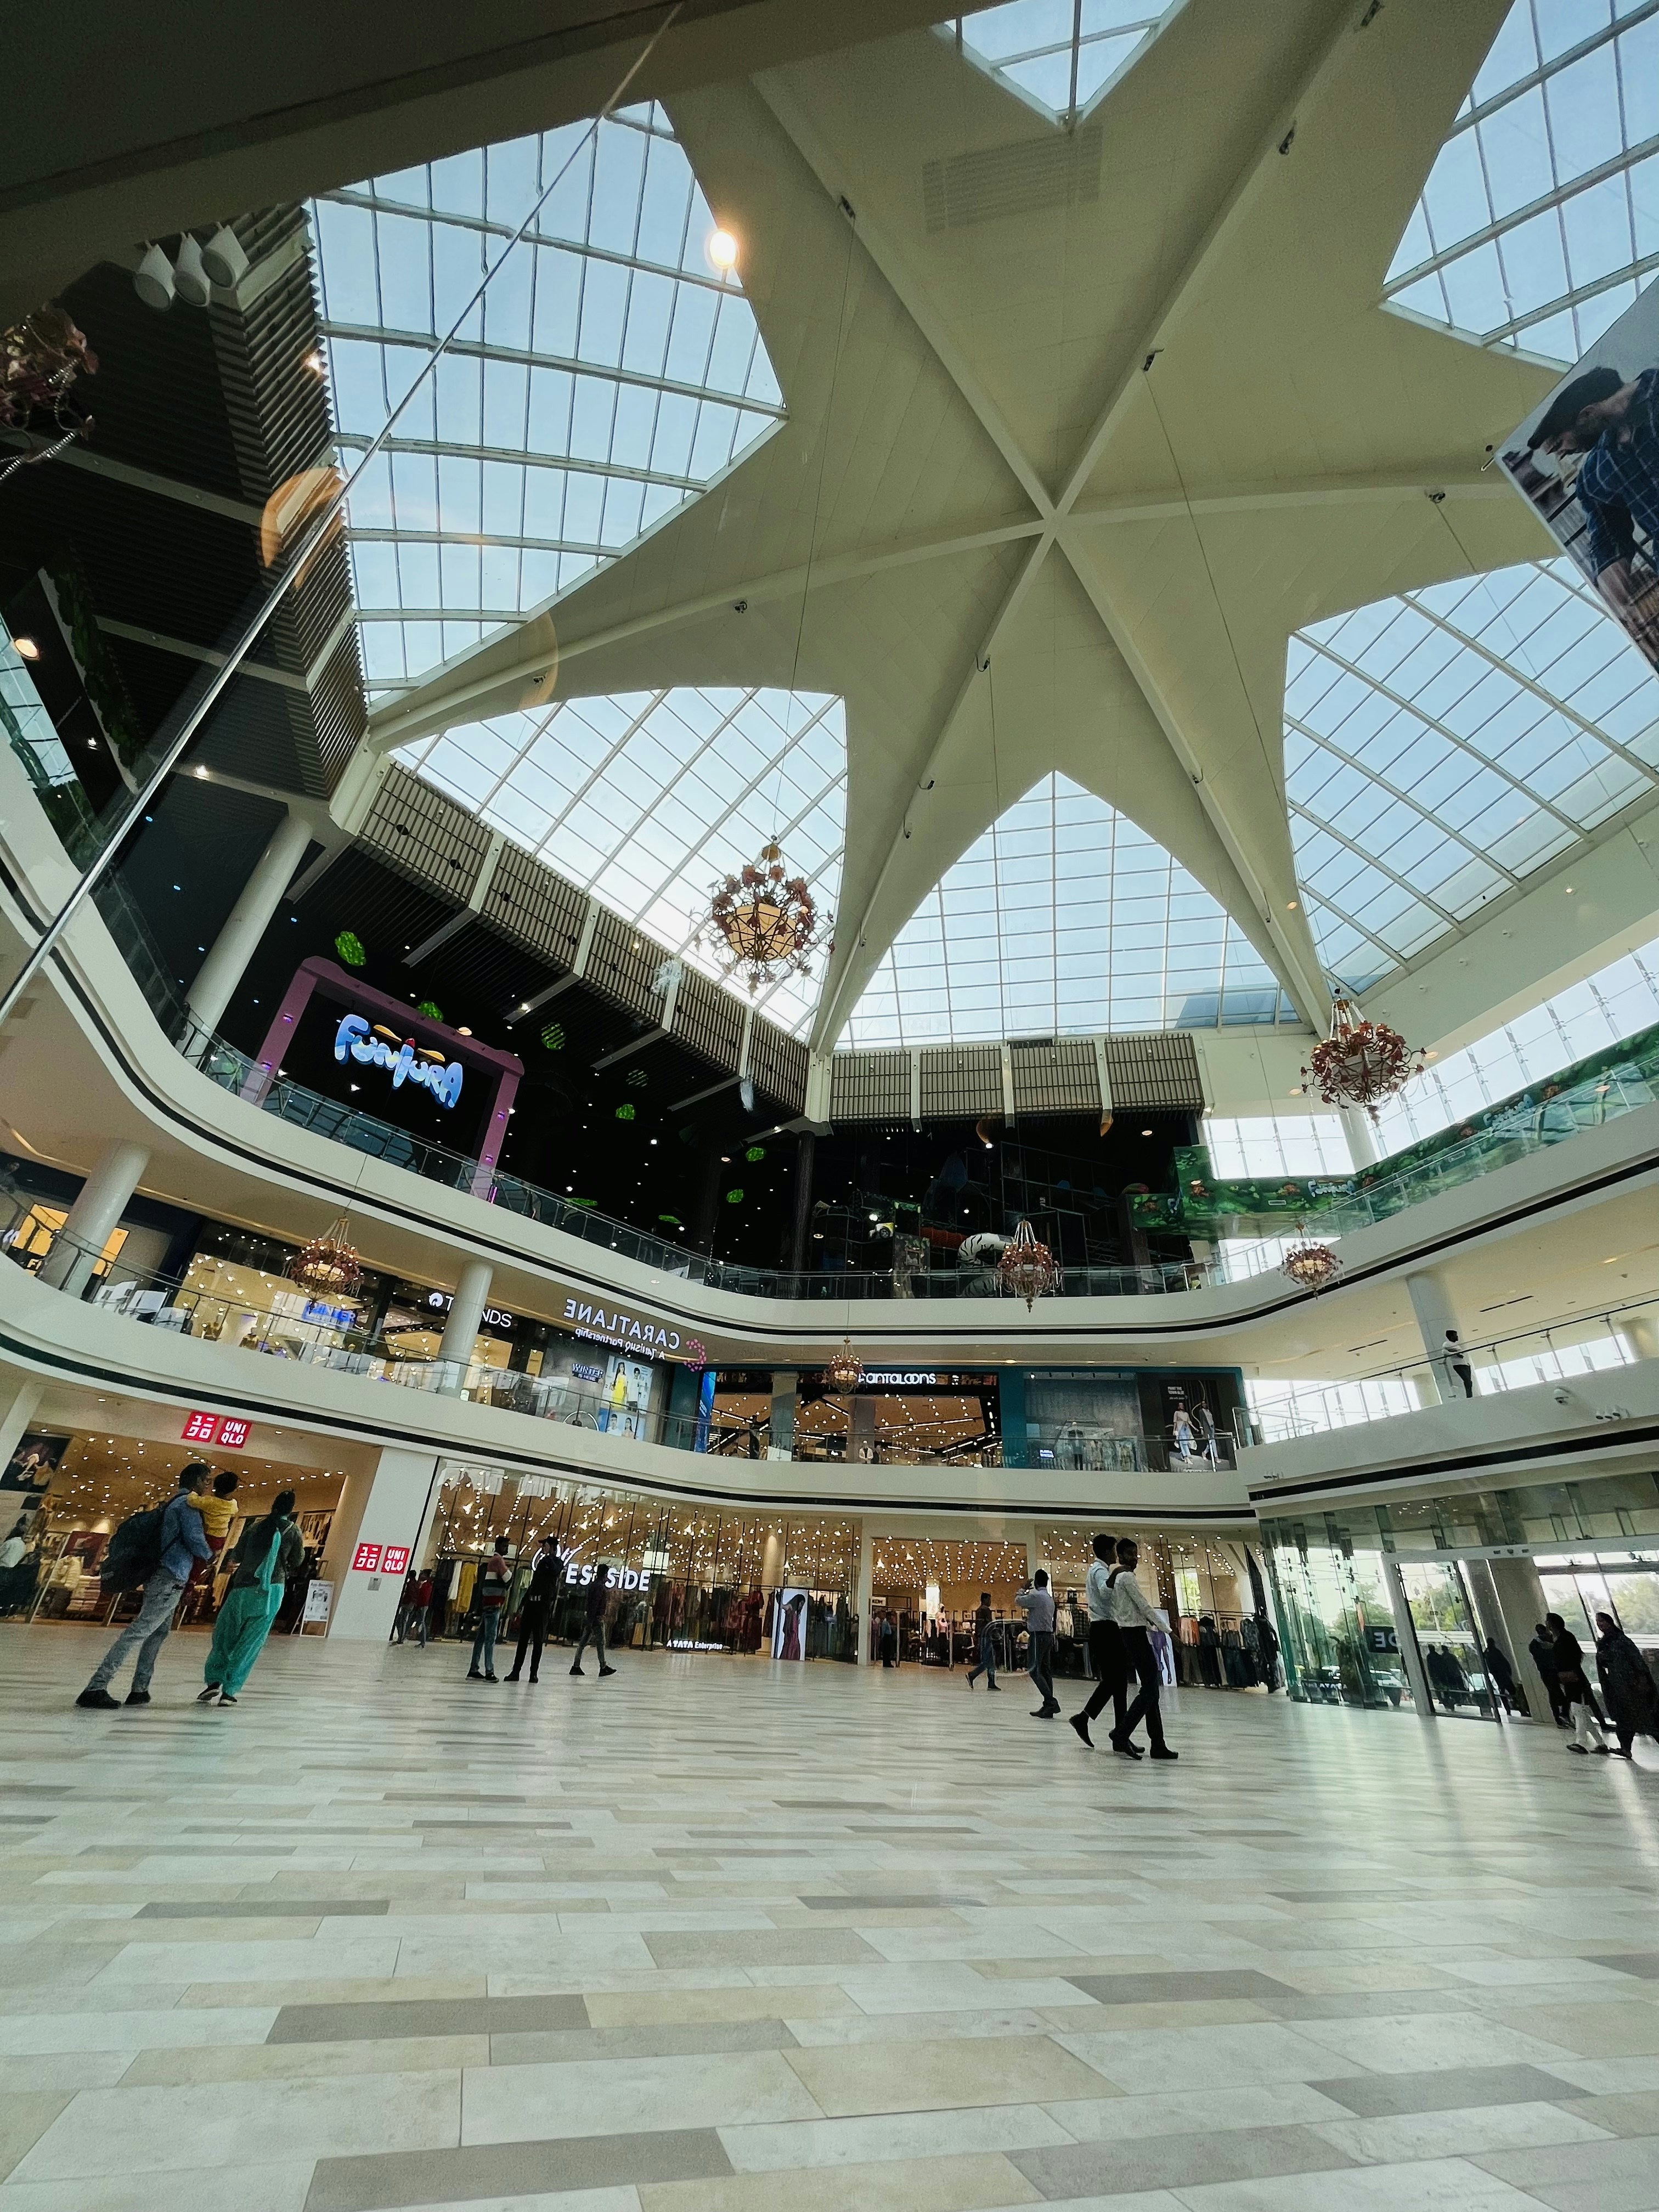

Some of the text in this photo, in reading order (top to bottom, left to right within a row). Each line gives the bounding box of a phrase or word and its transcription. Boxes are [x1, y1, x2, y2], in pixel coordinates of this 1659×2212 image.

[445, 1295, 512, 1328] TNDS
[225, 1421, 247, 1434] UNI
[221, 1432, 244, 1444] QLO
[387, 1549, 406, 1561] UNI
[384, 1559, 404, 1572] QLO
[667, 1639, 724, 1651] A TATA Enterprise
